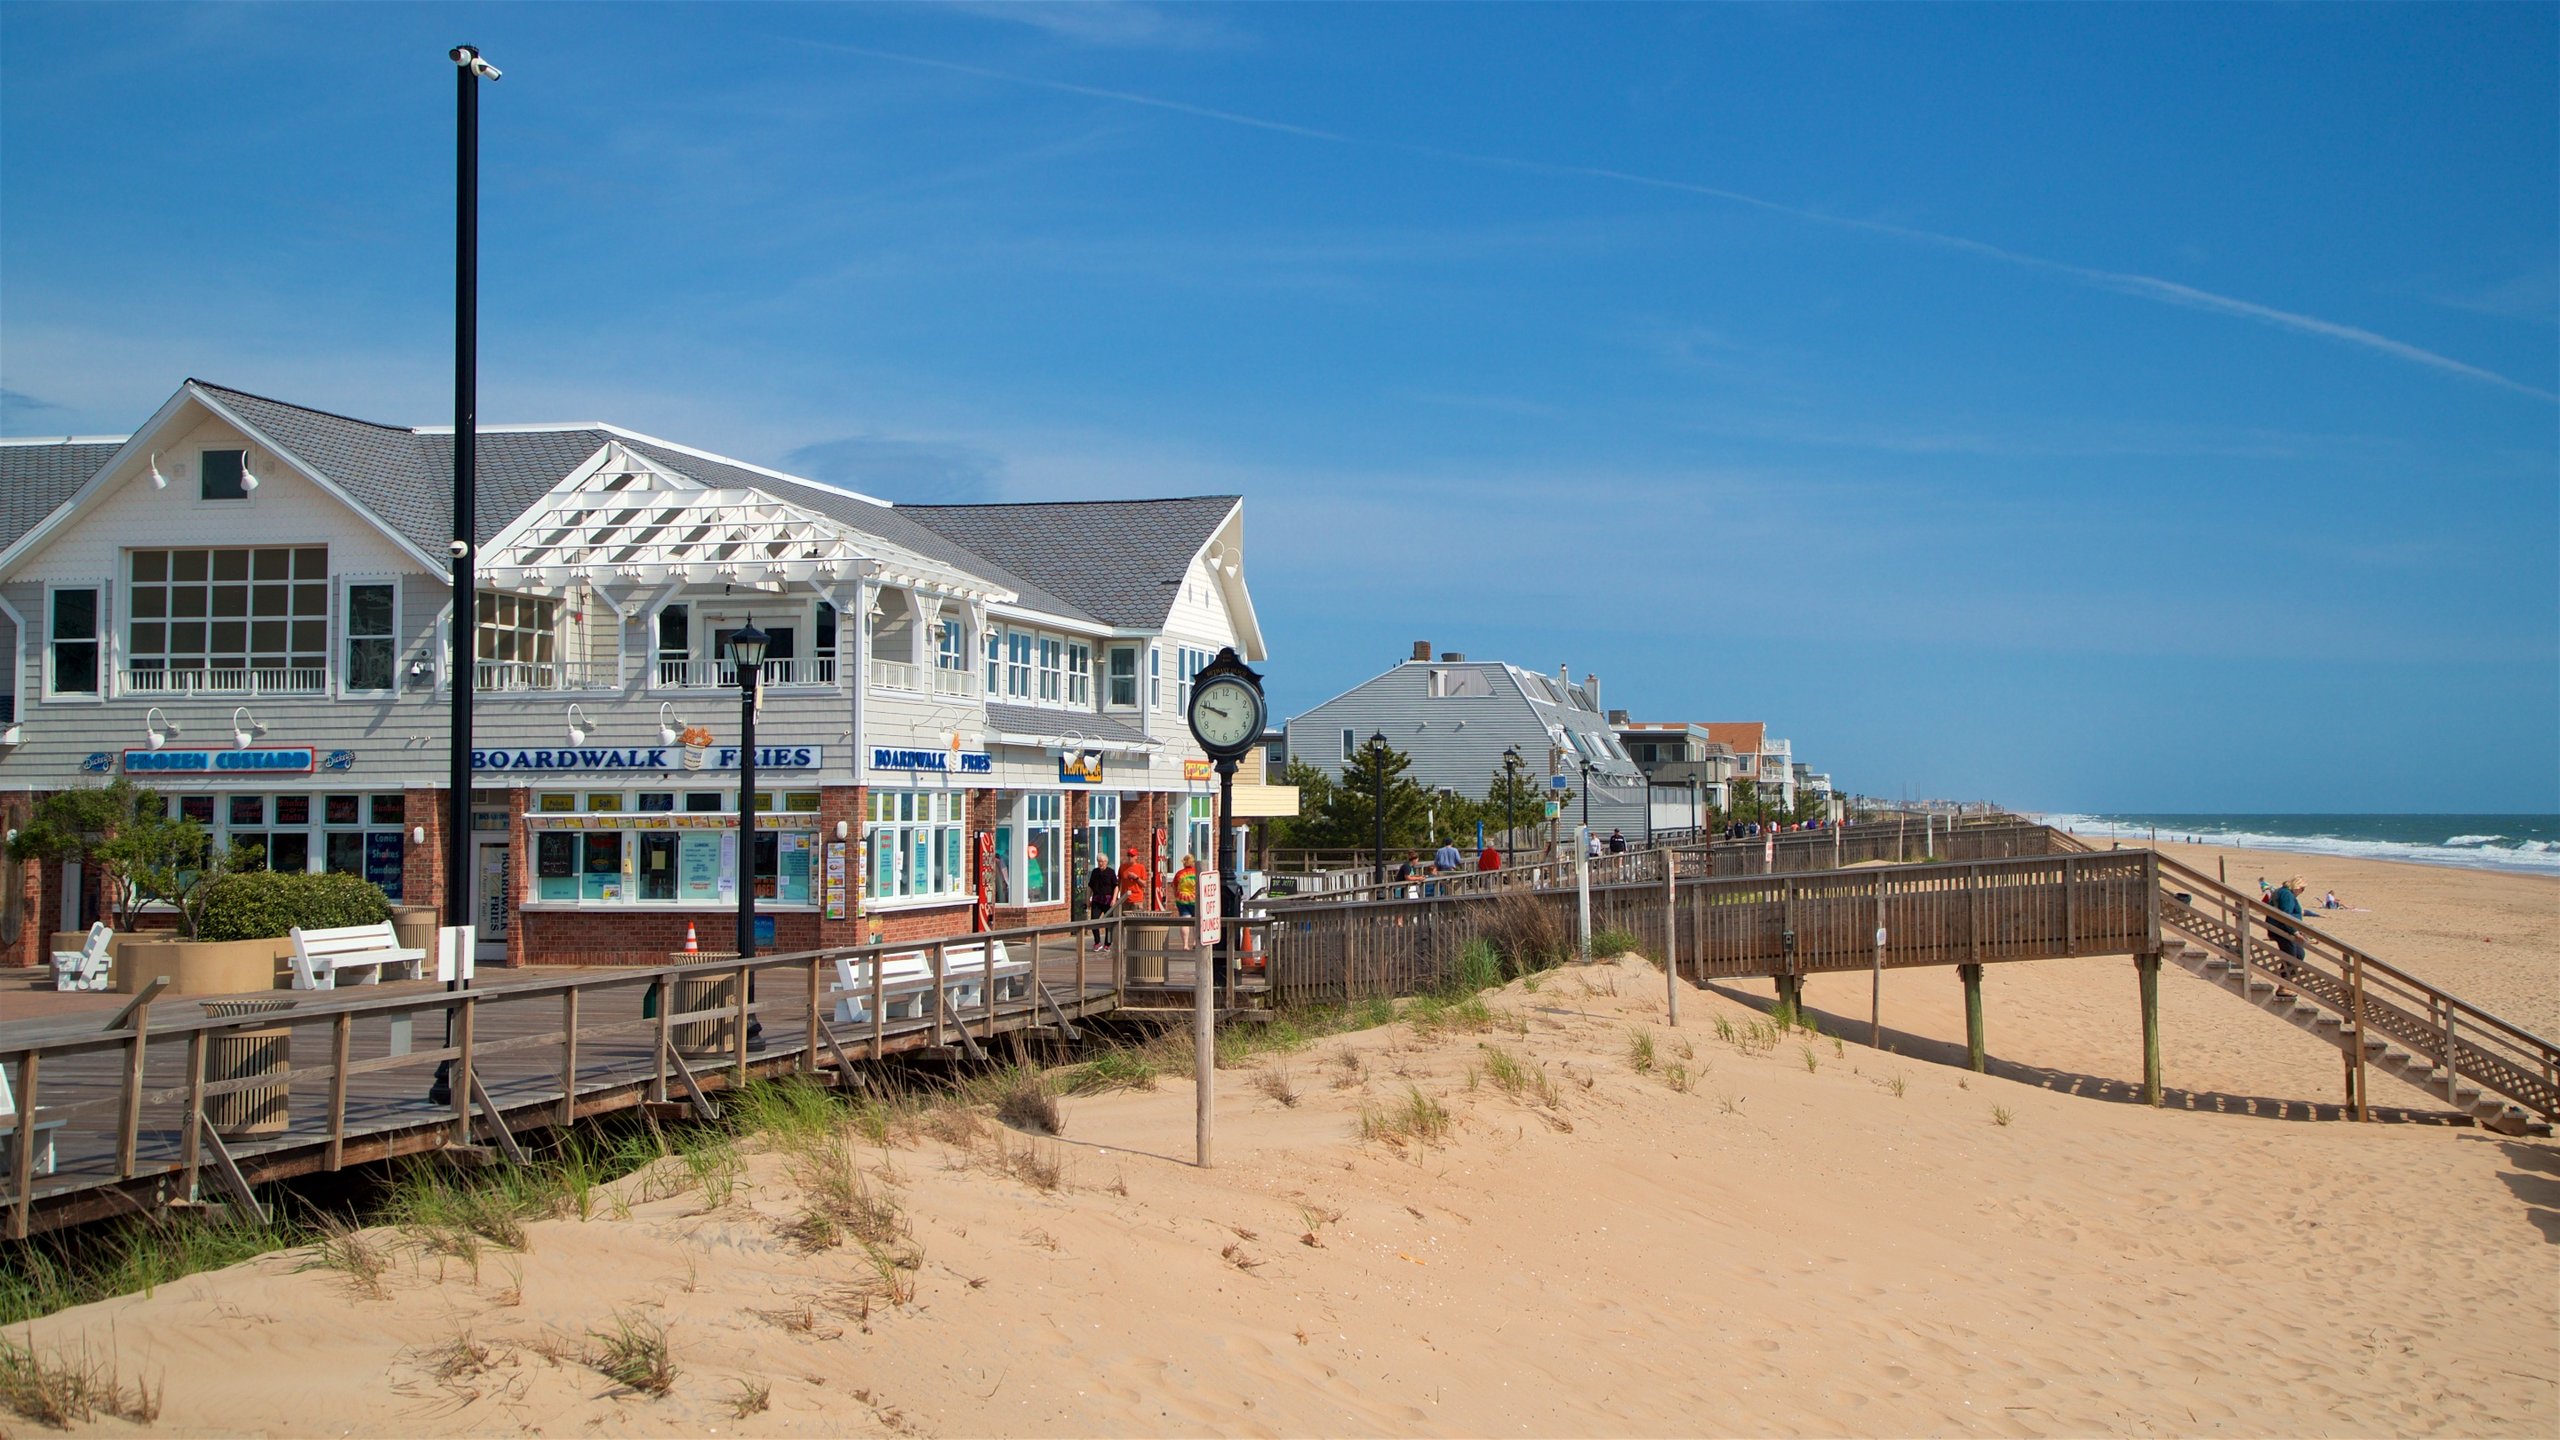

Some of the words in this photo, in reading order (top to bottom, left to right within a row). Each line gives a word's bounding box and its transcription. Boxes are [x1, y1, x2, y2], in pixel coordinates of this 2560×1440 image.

[125, 753, 208, 770] FROZEN
[215, 752, 310, 769] CUSTARD
[471, 750, 667, 768] BOARDWALK
[719, 748, 811, 767] FIES
[875, 750, 946, 769] BOARDWALK
[961, 754, 991, 771] FRIES
[375, 834, 397, 842] Cones
[372, 849, 399, 858] Shakes
[501, 852, 510, 931] BOARDWALK
[754, 884, 775, 897] LOSED
[1203, 884, 1217, 897] KEEP
[490, 896, 499, 931] FRIES
[1206, 901, 1216, 914] OFF
[1202, 918, 1220, 932] DUNES
